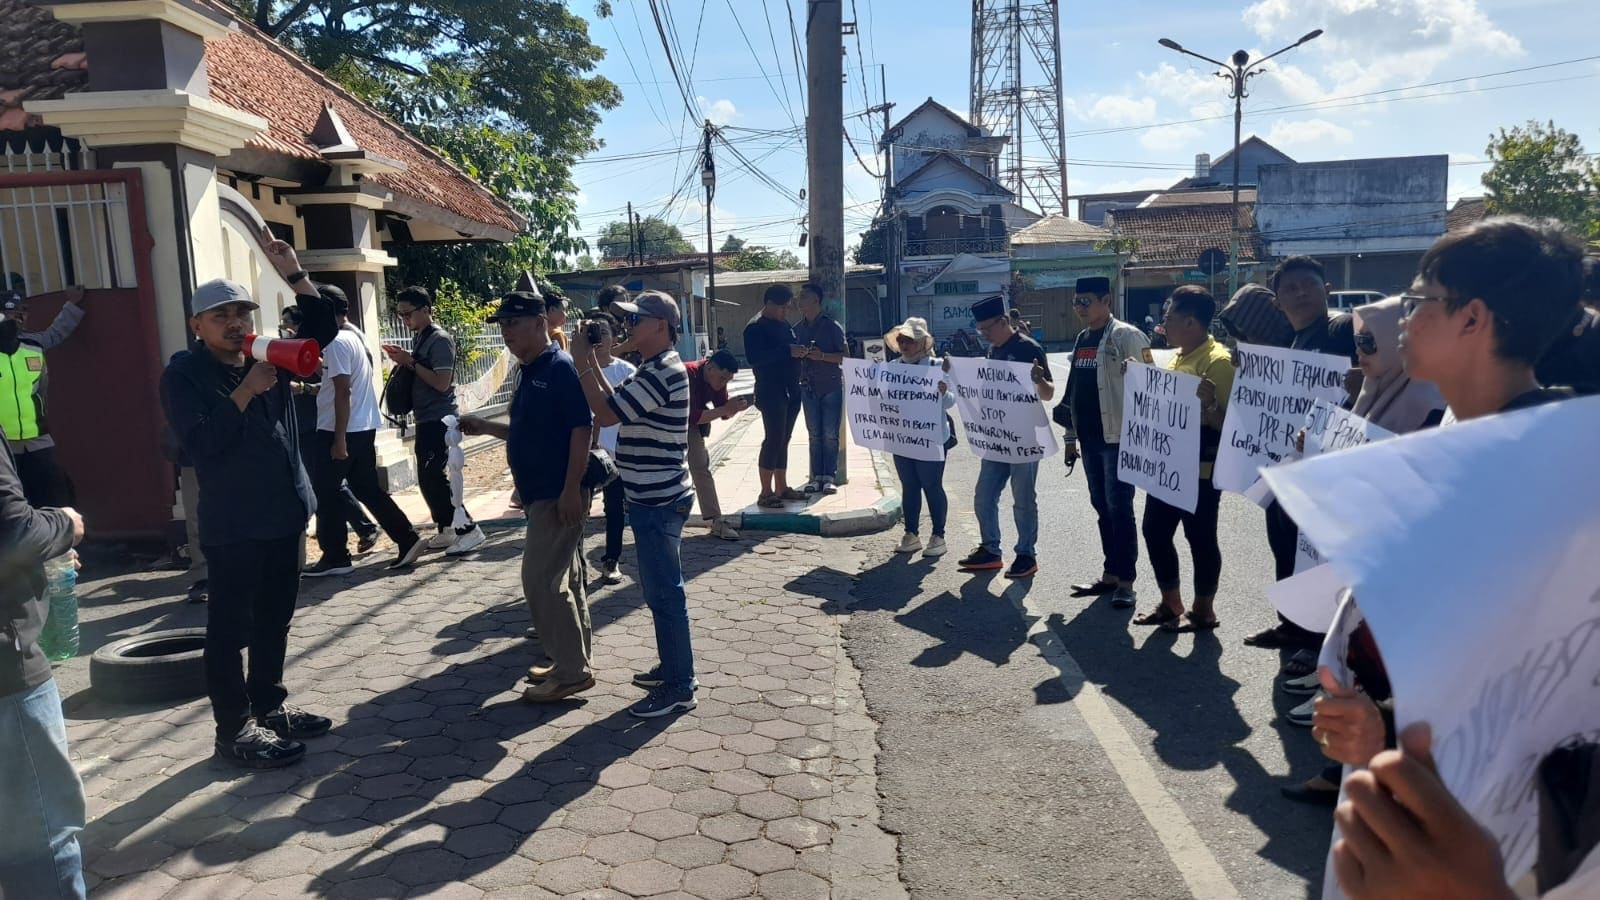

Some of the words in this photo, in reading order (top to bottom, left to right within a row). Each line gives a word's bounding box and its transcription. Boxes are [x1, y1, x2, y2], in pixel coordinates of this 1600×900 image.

[855, 367, 876, 380] RUU
[976, 367, 1022, 385] MENOLAK
[1239, 350, 1284, 385] DAPURKU
[1292, 360, 1344, 391] TERHALAN
[850, 384, 883, 400] ANCAM
[887, 389, 939, 403] KEBEBASAN
[981, 388, 994, 401] UU
[1234, 386, 1266, 407] REVISI
[1267, 394, 1280, 414] UU
[880, 402, 900, 414] PERS
[981, 407, 1006, 424] STOP
[1133, 391, 1160, 423] MAFIA
[880, 415, 900, 427] PERS
[862, 429, 894, 442] LEMAH
[896, 433, 936, 449] SYAWAT
[1127, 420, 1150, 448] KAMI
[1151, 429, 1174, 456] PERS
[1016, 445, 1046, 457] PERS
[1120, 450, 1142, 473] BUKAN
